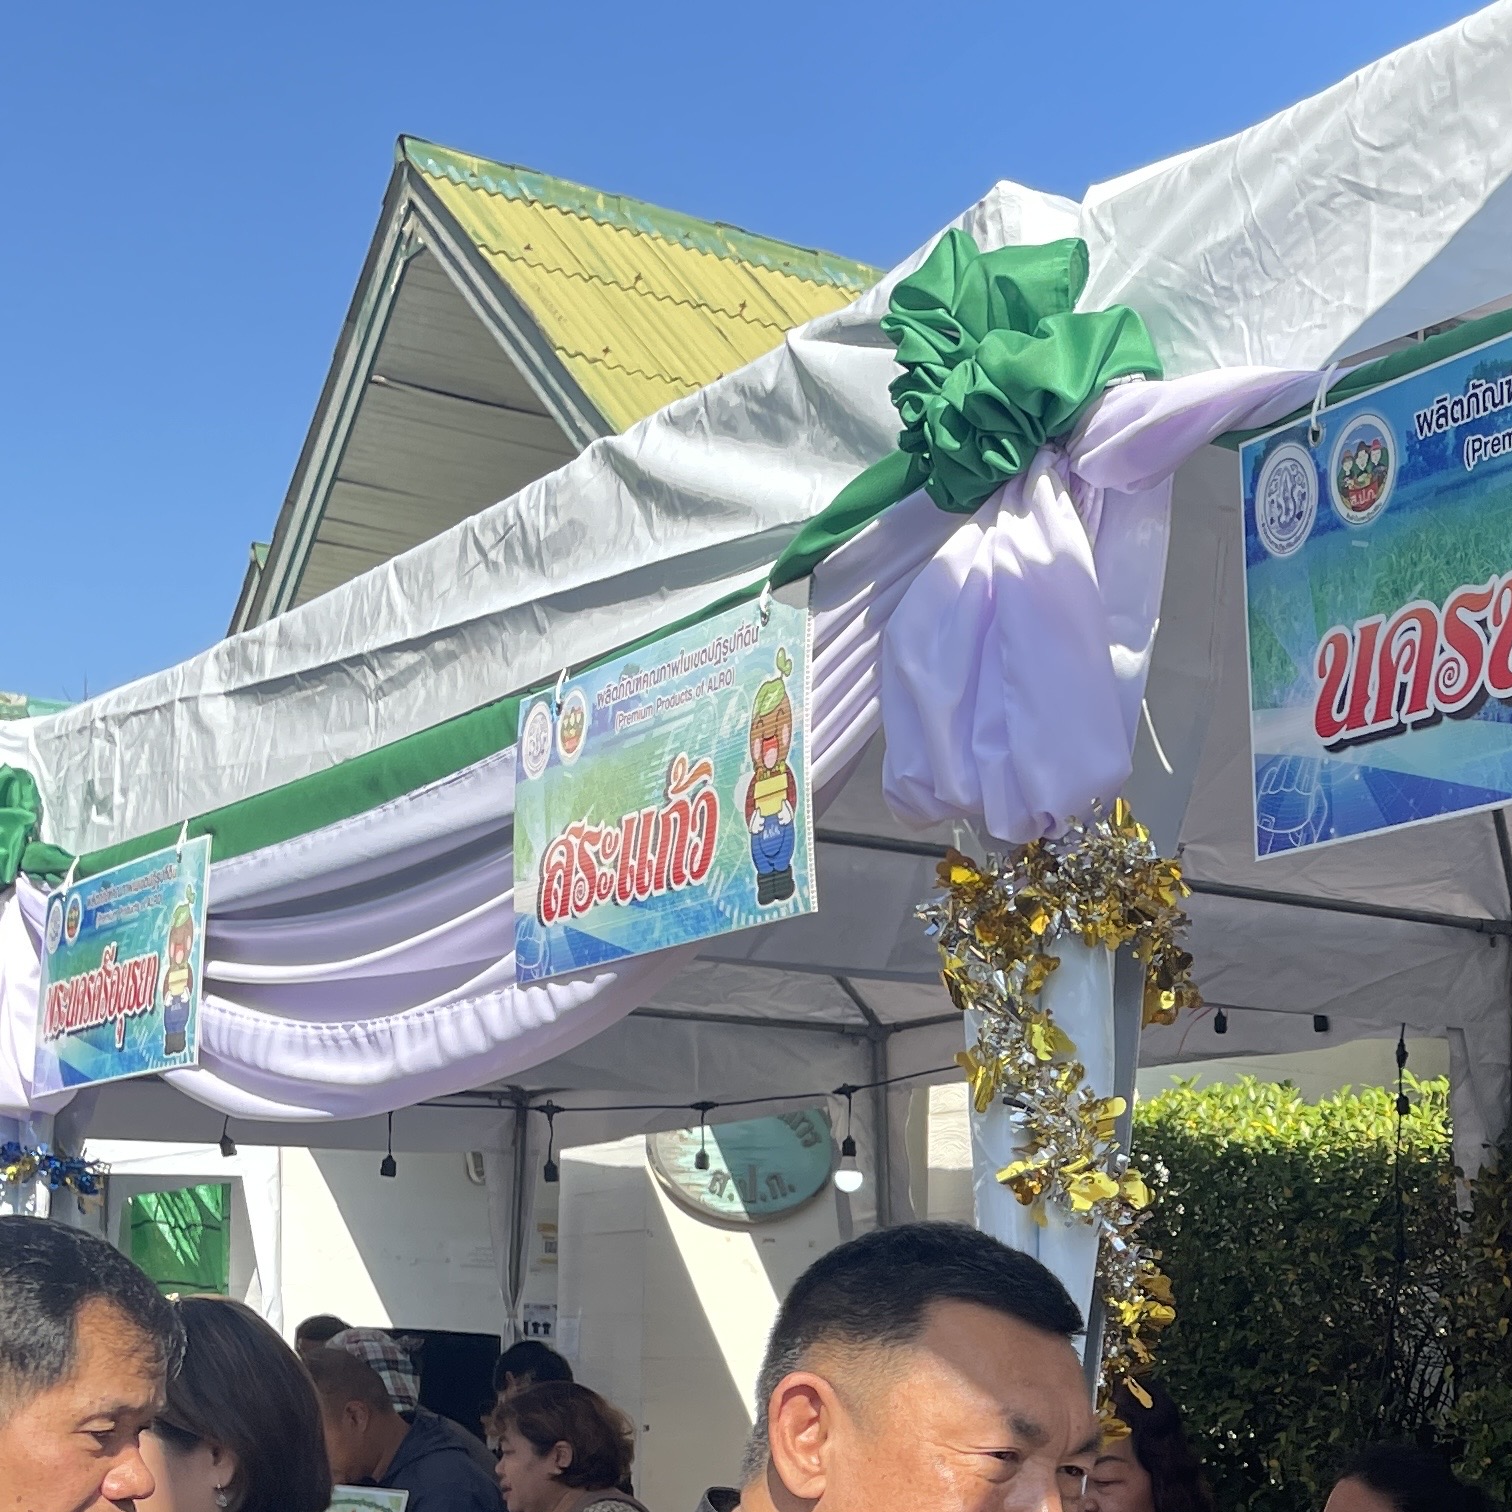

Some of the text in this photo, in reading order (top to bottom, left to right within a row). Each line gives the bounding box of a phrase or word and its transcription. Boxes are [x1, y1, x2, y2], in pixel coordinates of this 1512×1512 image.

[614, 666, 736, 735] (Premium Products of ALRO)
[541, 752, 721, 927] สระแก้ว
